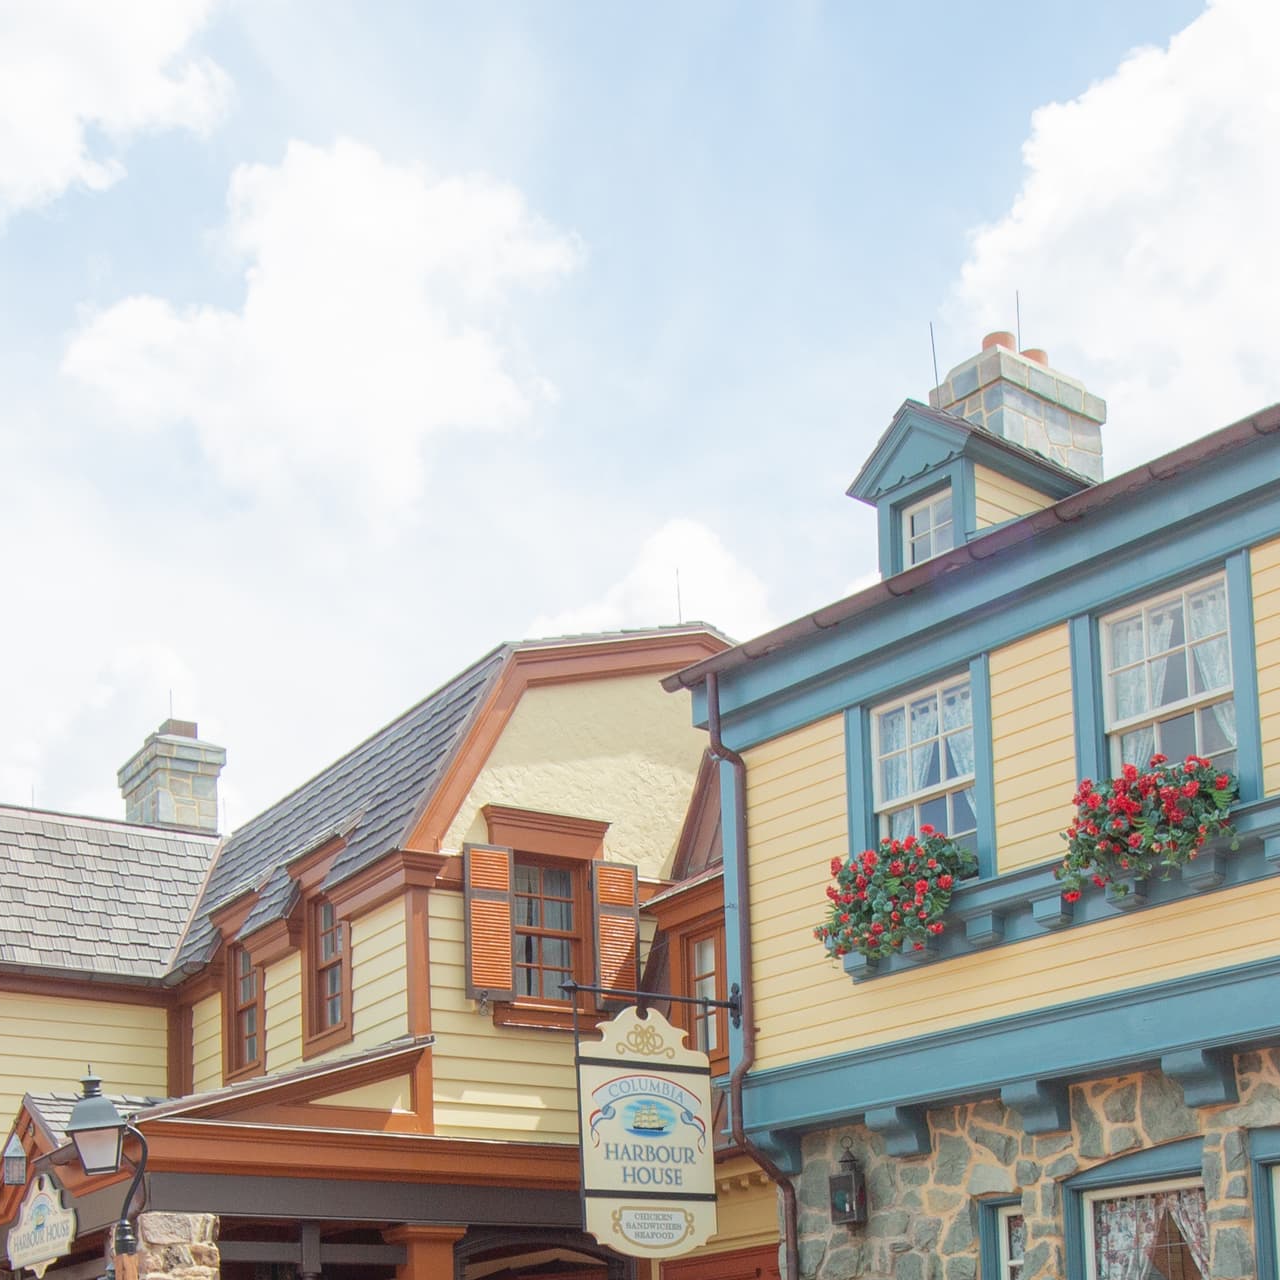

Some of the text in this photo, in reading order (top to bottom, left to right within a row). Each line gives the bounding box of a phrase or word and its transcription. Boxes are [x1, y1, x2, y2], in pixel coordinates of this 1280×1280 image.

[608, 1078, 685, 1105] COLUMBIA
[603, 1143, 696, 1165] HARBOUR
[621, 1166, 684, 1186] HOUSE
[634, 1212, 673, 1221] CHICKEN
[625, 1221, 682, 1230] SANDWICHES
[634, 1231, 674, 1239] SEAFOOD
